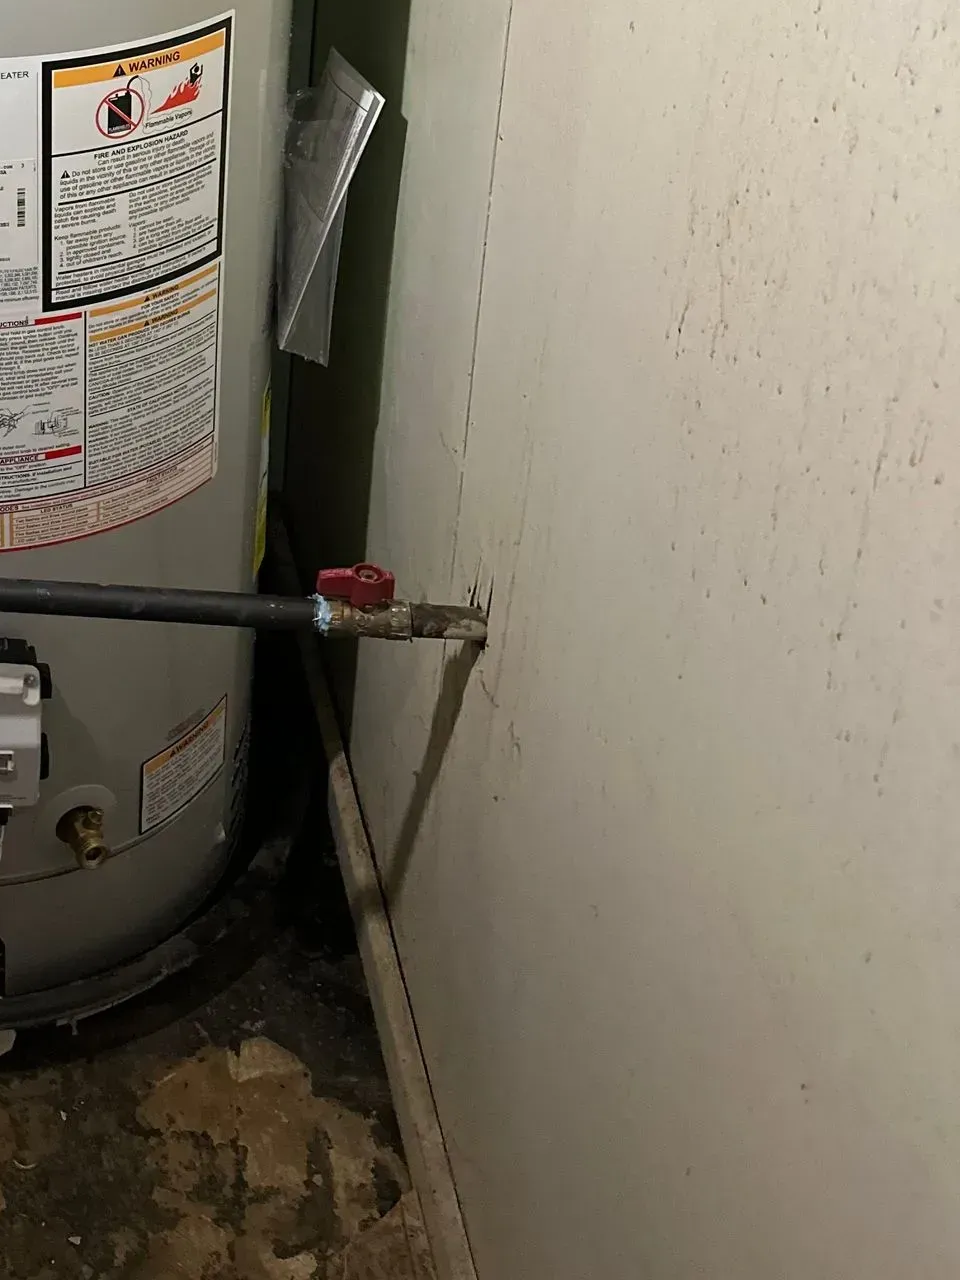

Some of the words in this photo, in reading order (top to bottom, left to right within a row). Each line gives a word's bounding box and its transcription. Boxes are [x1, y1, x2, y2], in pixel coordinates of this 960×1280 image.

[128, 50, 181, 73] WARNING
[144, 114, 176, 128] Flammable
[174, 110, 192, 120] Vapors
[94, 152, 110, 160] FIRE
[110, 148, 126, 156] AND
[126, 137, 164, 154] EXPLOSION
[164, 130, 190, 142] HAZARD
[92, 166, 106, 174] store
[114, 162, 124, 170] use
[124, 156, 146, 168] gasoline
[154, 150, 168, 160] other
[168, 144, 190, 156] flammable
[190, 136, 206, 148] vapors
[98, 158, 110, 166] Can
[110, 156, 126, 164] result
[132, 150, 152, 160] serious
[152, 146, 164, 156] injury
[60, 178, 78, 186] liquids
[96, 170, 116, 180] vicinity
[150, 158, 164, 168] other
[78, 180, 102, 192] gasoline
[110, 176, 126, 186] other
[124, 168, 152, 180] flammable
[152, 164, 170, 176] vapors
[174, 156, 192, 168] liquids
[66, 192, 78, 200] this
[98, 184, 112, 194] other
[112, 178, 138, 192] appliance
[54, 204, 74, 214] Vapors
[74, 202, 88, 212] from
[88, 196, 116, 208] flammable
[70, 228, 98, 240] flammable
[152, 284, 180, 300] WARNING
[152, 298, 164, 308] YOUR
[164, 292, 180, 302] SAFETY
[151, 308, 179, 324] WARNING
[100, 338, 118, 346] WATER
[128, 326, 150, 338] PRODUCE
[0, 456, 38, 464] APPLIANCE
[52, 504, 74, 512] STATUS
